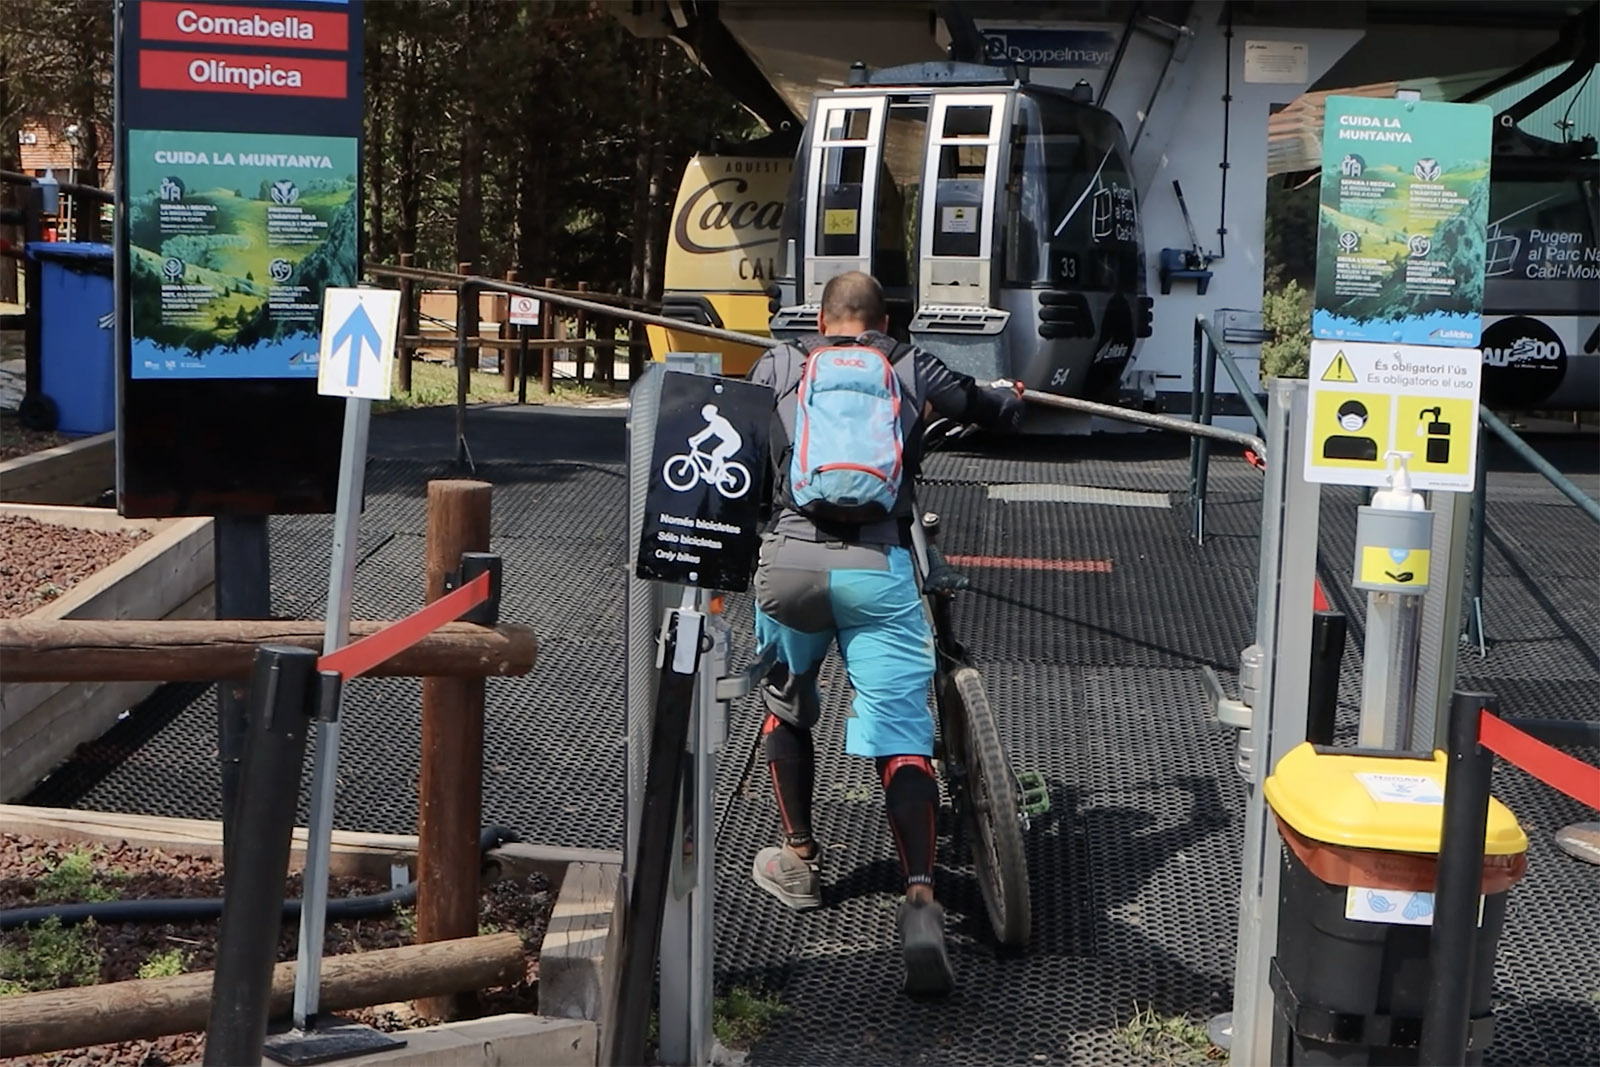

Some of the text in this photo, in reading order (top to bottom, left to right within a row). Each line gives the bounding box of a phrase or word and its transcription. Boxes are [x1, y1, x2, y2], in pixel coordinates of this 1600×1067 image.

[176, 10, 313, 40] Comabella
[1007, 46, 1110, 64] Doppelmayr
[189, 59, 302, 90] Olímpica
[1339, 115, 1401, 128] CUIDA LA
[1339, 129, 1412, 143] MUNTANYA
[154, 150, 333, 169] CUIDA LA MUNTANYA
[725, 162, 778, 173] AQUEST
[675, 177, 785, 254] Caca
[1529, 229, 1583, 246] Pugem
[1528, 247, 1543, 261] al
[1545, 247, 1581, 261] Parc
[738, 258, 776, 280] CAL
[1061, 257, 1076, 278] 33
[1374, 360, 1467, 375] És obligatori l'ús
[1050, 368, 1071, 386] 54
[1367, 373, 1474, 389] Es obligatorio el uso
[660, 513, 741, 534] Només bicicletes
[657, 531, 722, 549] Sólo bicicletas
[655, 548, 700, 564] Only bikes
